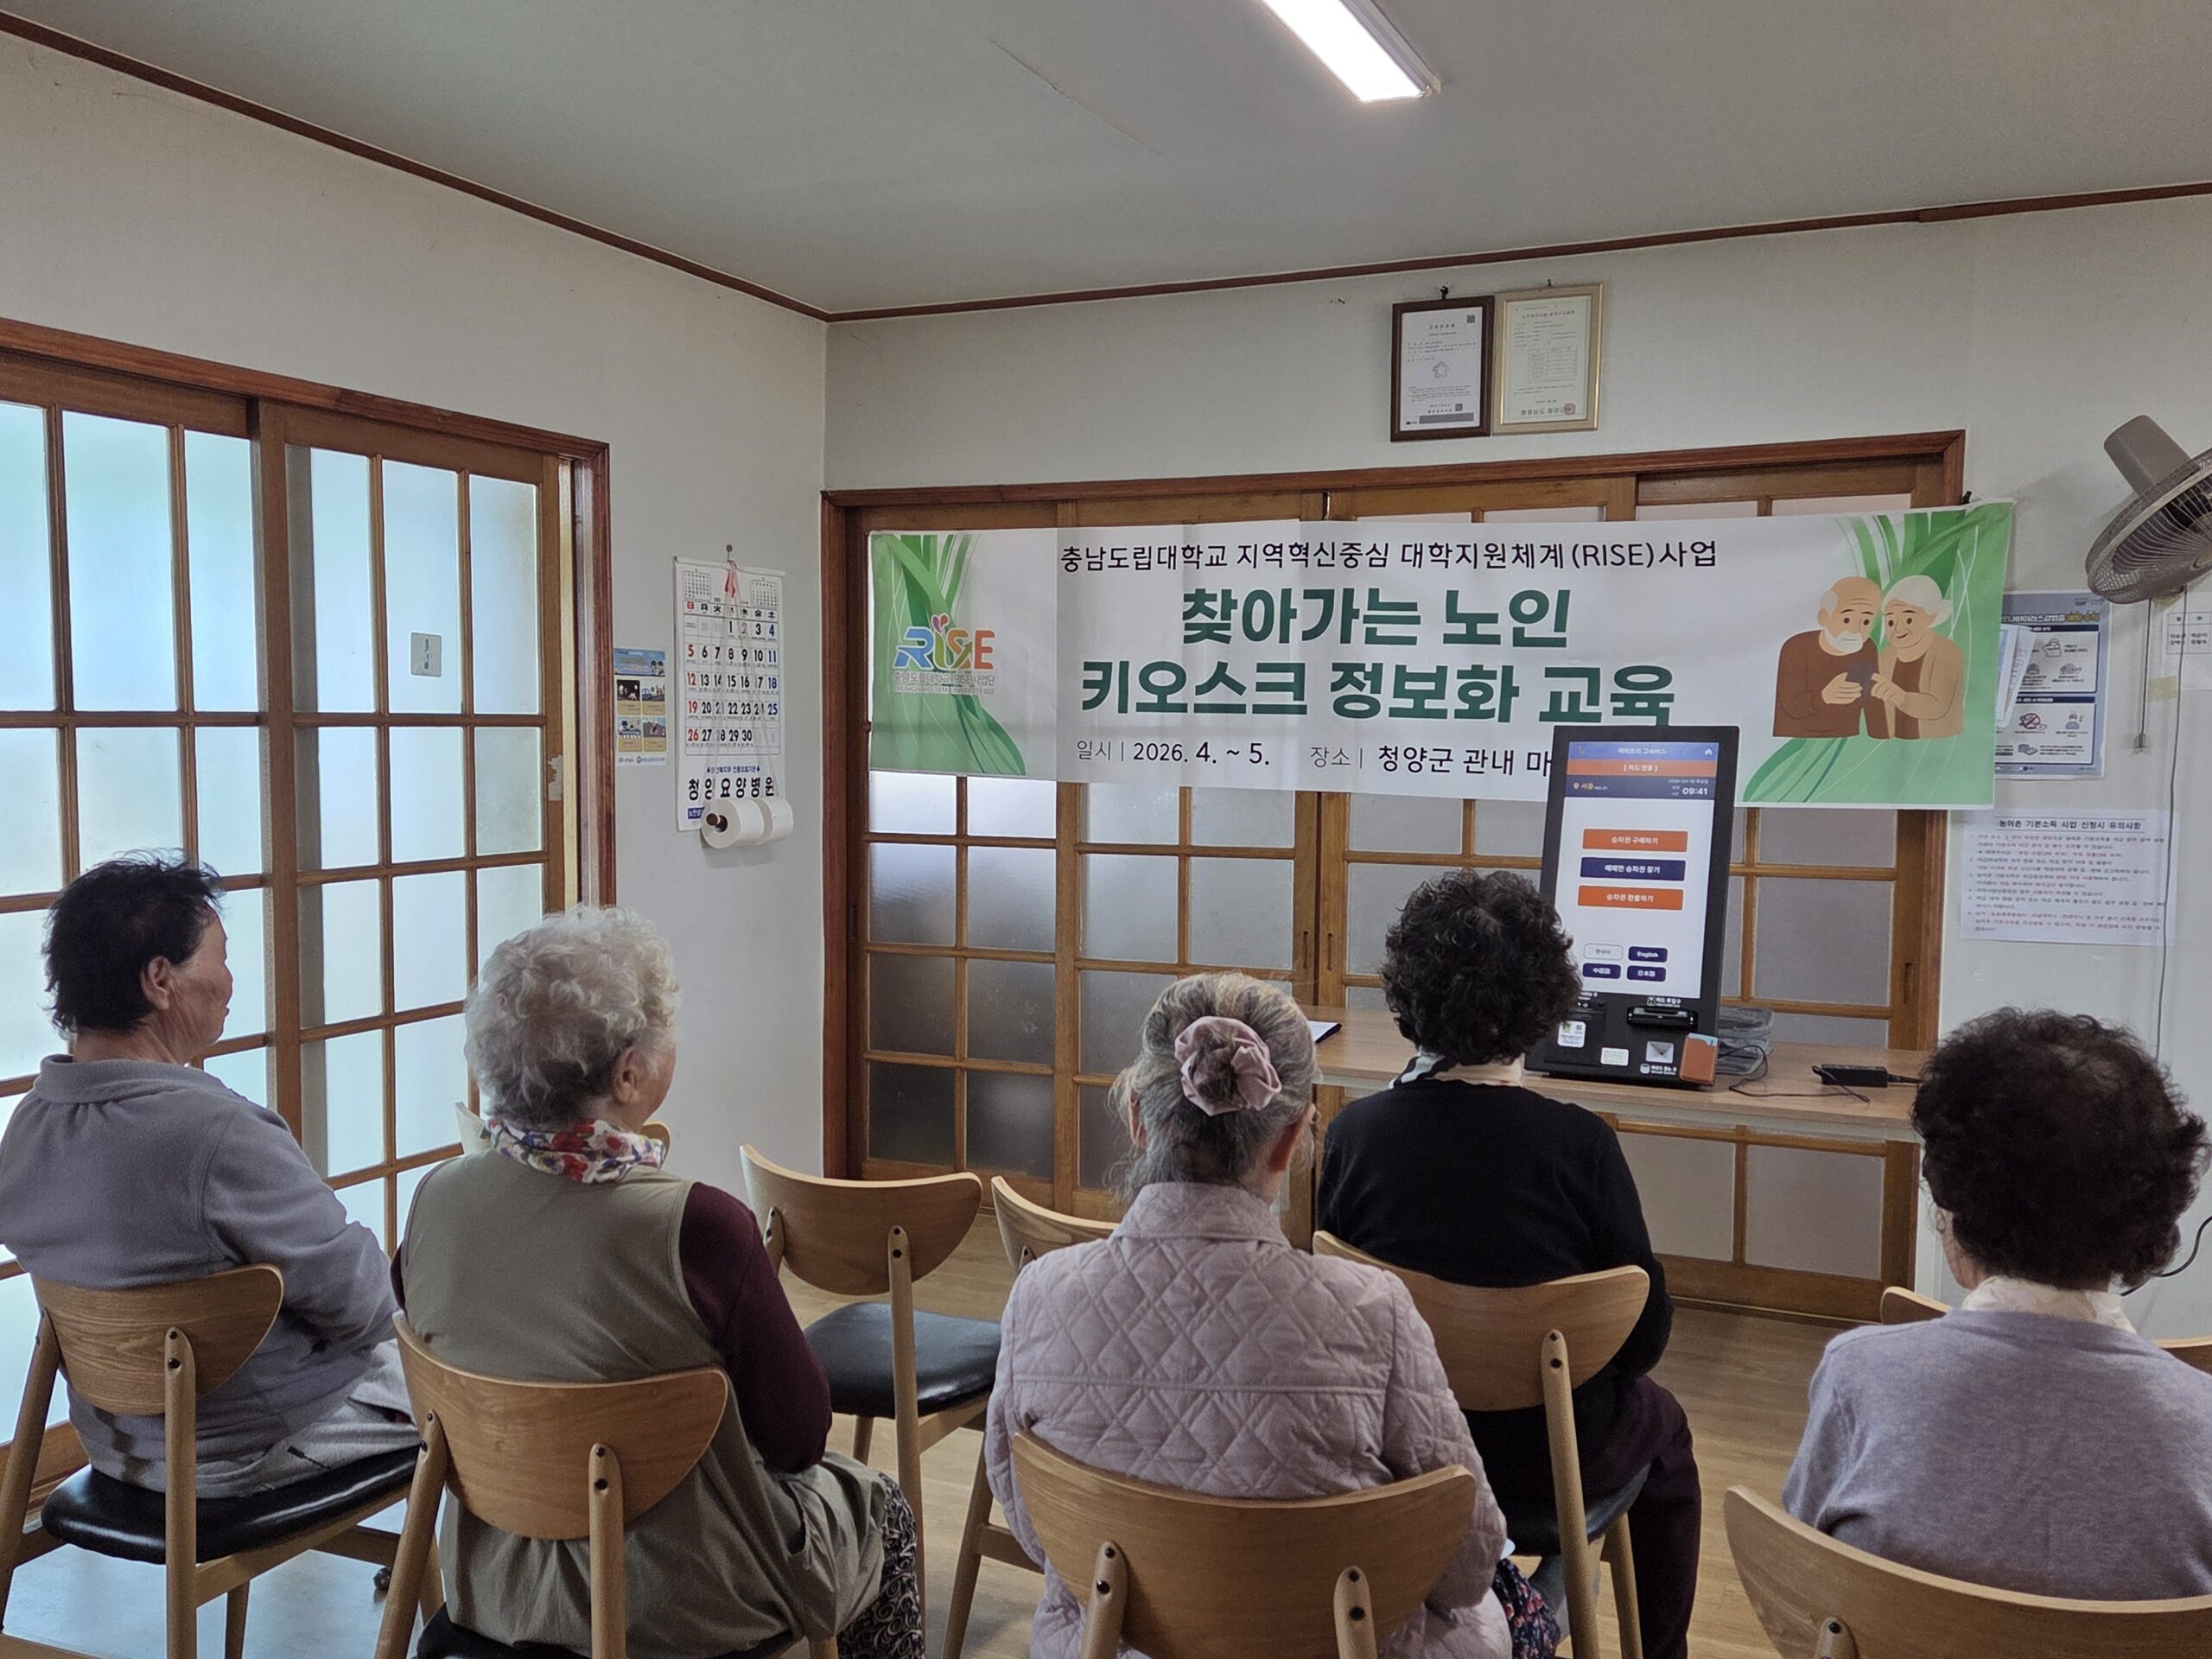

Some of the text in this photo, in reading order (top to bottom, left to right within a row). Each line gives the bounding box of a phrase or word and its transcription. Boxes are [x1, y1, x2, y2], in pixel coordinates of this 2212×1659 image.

[1060, 540, 1717, 572] 충남도립대학교 지역혁신중심 대학지원체계(RISE)사업
[1183, 588, 1571, 648] 찾아가는 노인
[728, 621, 775, 636] 1 2 3 4
[688, 644, 777, 663] 5 6 7 8 9 10 11
[687, 672, 696, 686] 12
[701, 674, 709, 686] 13
[728, 675, 736, 688] 15
[741, 676, 750, 688] 16
[768, 677, 777, 689] 18
[1082, 660, 1675, 726] 키오스크 정보화 교육
[689, 701, 698, 714] 19
[702, 702, 712, 714] 20
[715, 702, 725, 715] 21
[728, 702, 738, 715] 22
[741, 702, 751, 715] 23
[768, 703, 778, 715] 25
[688, 728, 753, 741] 26 27 28 29 30
[1077, 741, 1112, 761] 일시
[1133, 742, 1188, 763] 2026.
[1196, 741, 1217, 765] 4.
[1249, 742, 1269, 766] 5.
[1310, 746, 1351, 768] 장소
[1378, 745, 1454, 773] 청양군
[1463, 748, 1514, 776] 관내
[1999, 819, 2022, 828] 농어촌
[2061, 820, 2077, 829] 사업
[2082, 821, 2106, 830] 신청시
[2109, 821, 2142, 830] 유의사항
[1611, 836, 1631, 844] 승차권
[1626, 865, 1645, 874] 승차권
[1607, 893, 1626, 902] 승차권
